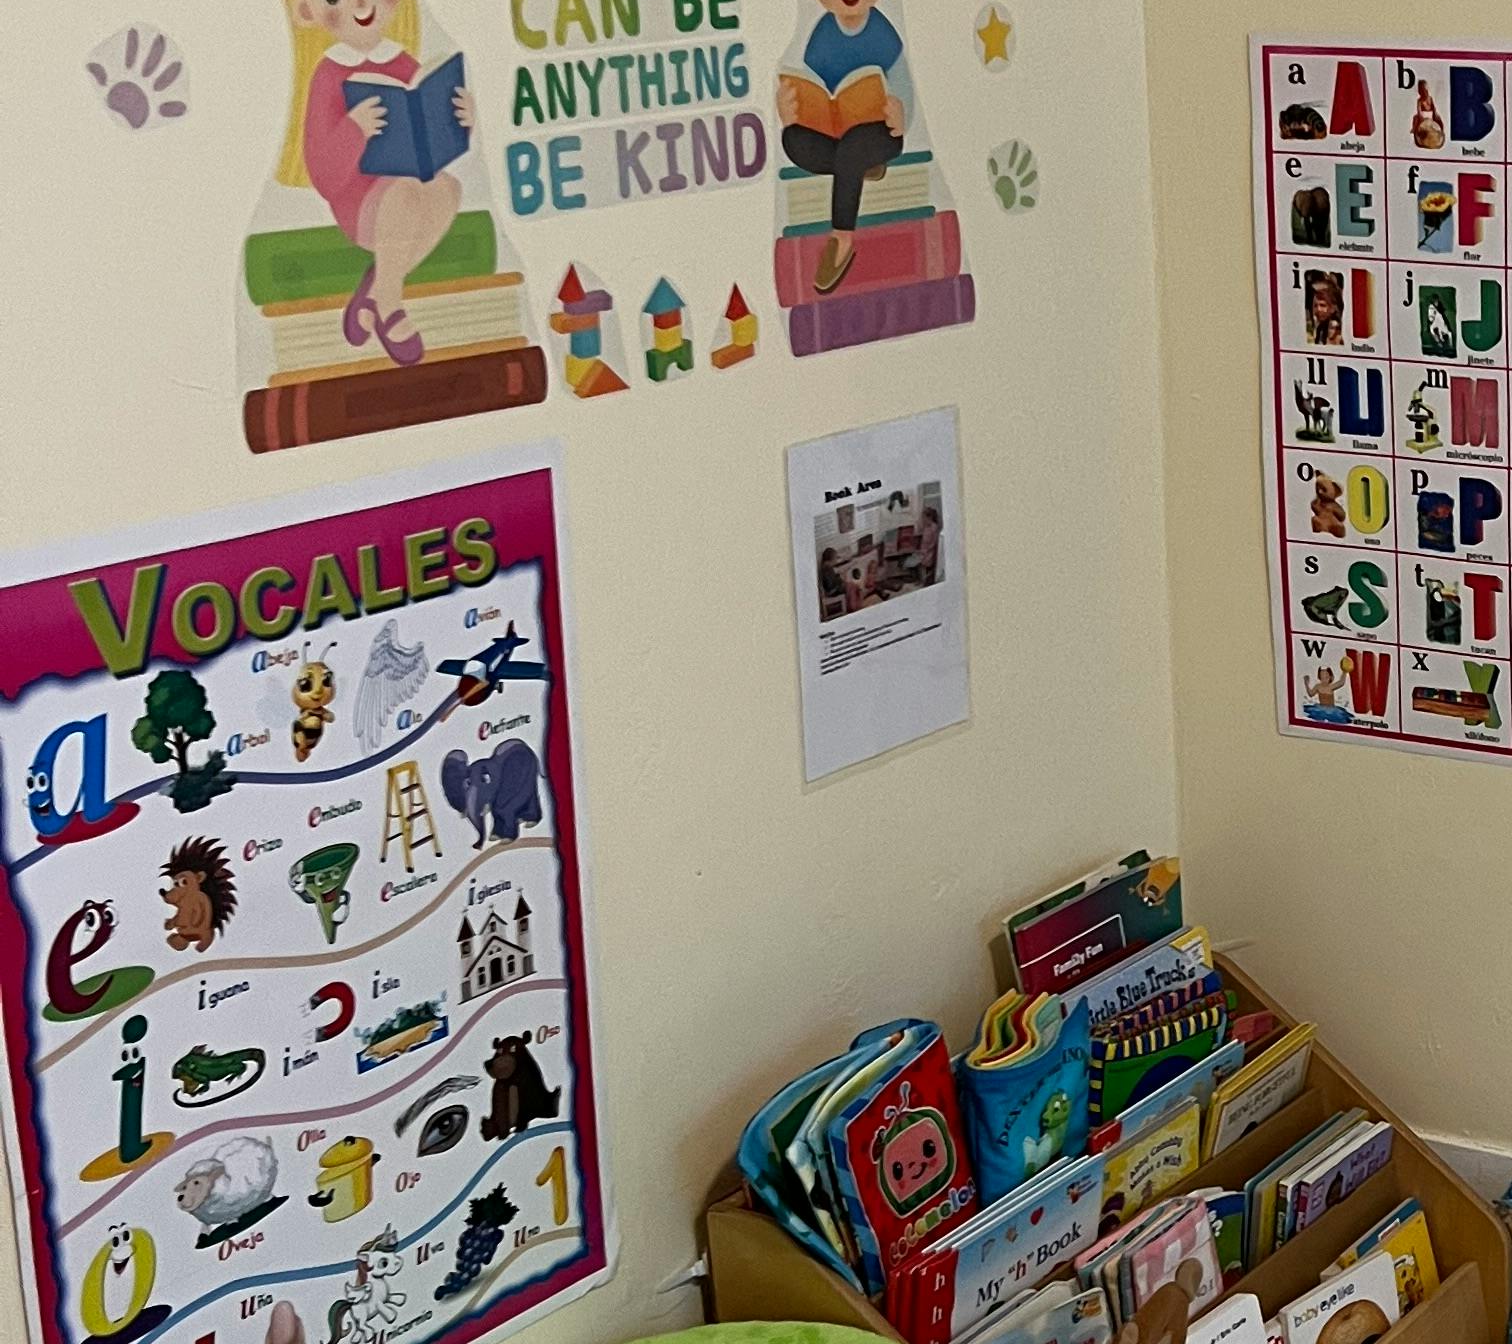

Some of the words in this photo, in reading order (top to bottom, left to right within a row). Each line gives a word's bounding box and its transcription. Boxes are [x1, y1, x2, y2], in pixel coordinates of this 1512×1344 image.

[512, 43, 749, 126] ANYTHING
[1288, 63, 1306, 85] a
[1330, 62, 1375, 136] A
[1397, 60, 1415, 89] b
[1450, 66, 1495, 141] B
[506, 135, 586, 216] BE
[616, 112, 767, 199] KIND
[1054, 950, 1086, 976] Family
[1116, 980, 1149, 1008] Blue
[975, 1276, 1005, 1307] My
[1035, 1220, 1083, 1268] Book
[1294, 1304, 1319, 1328] baby
